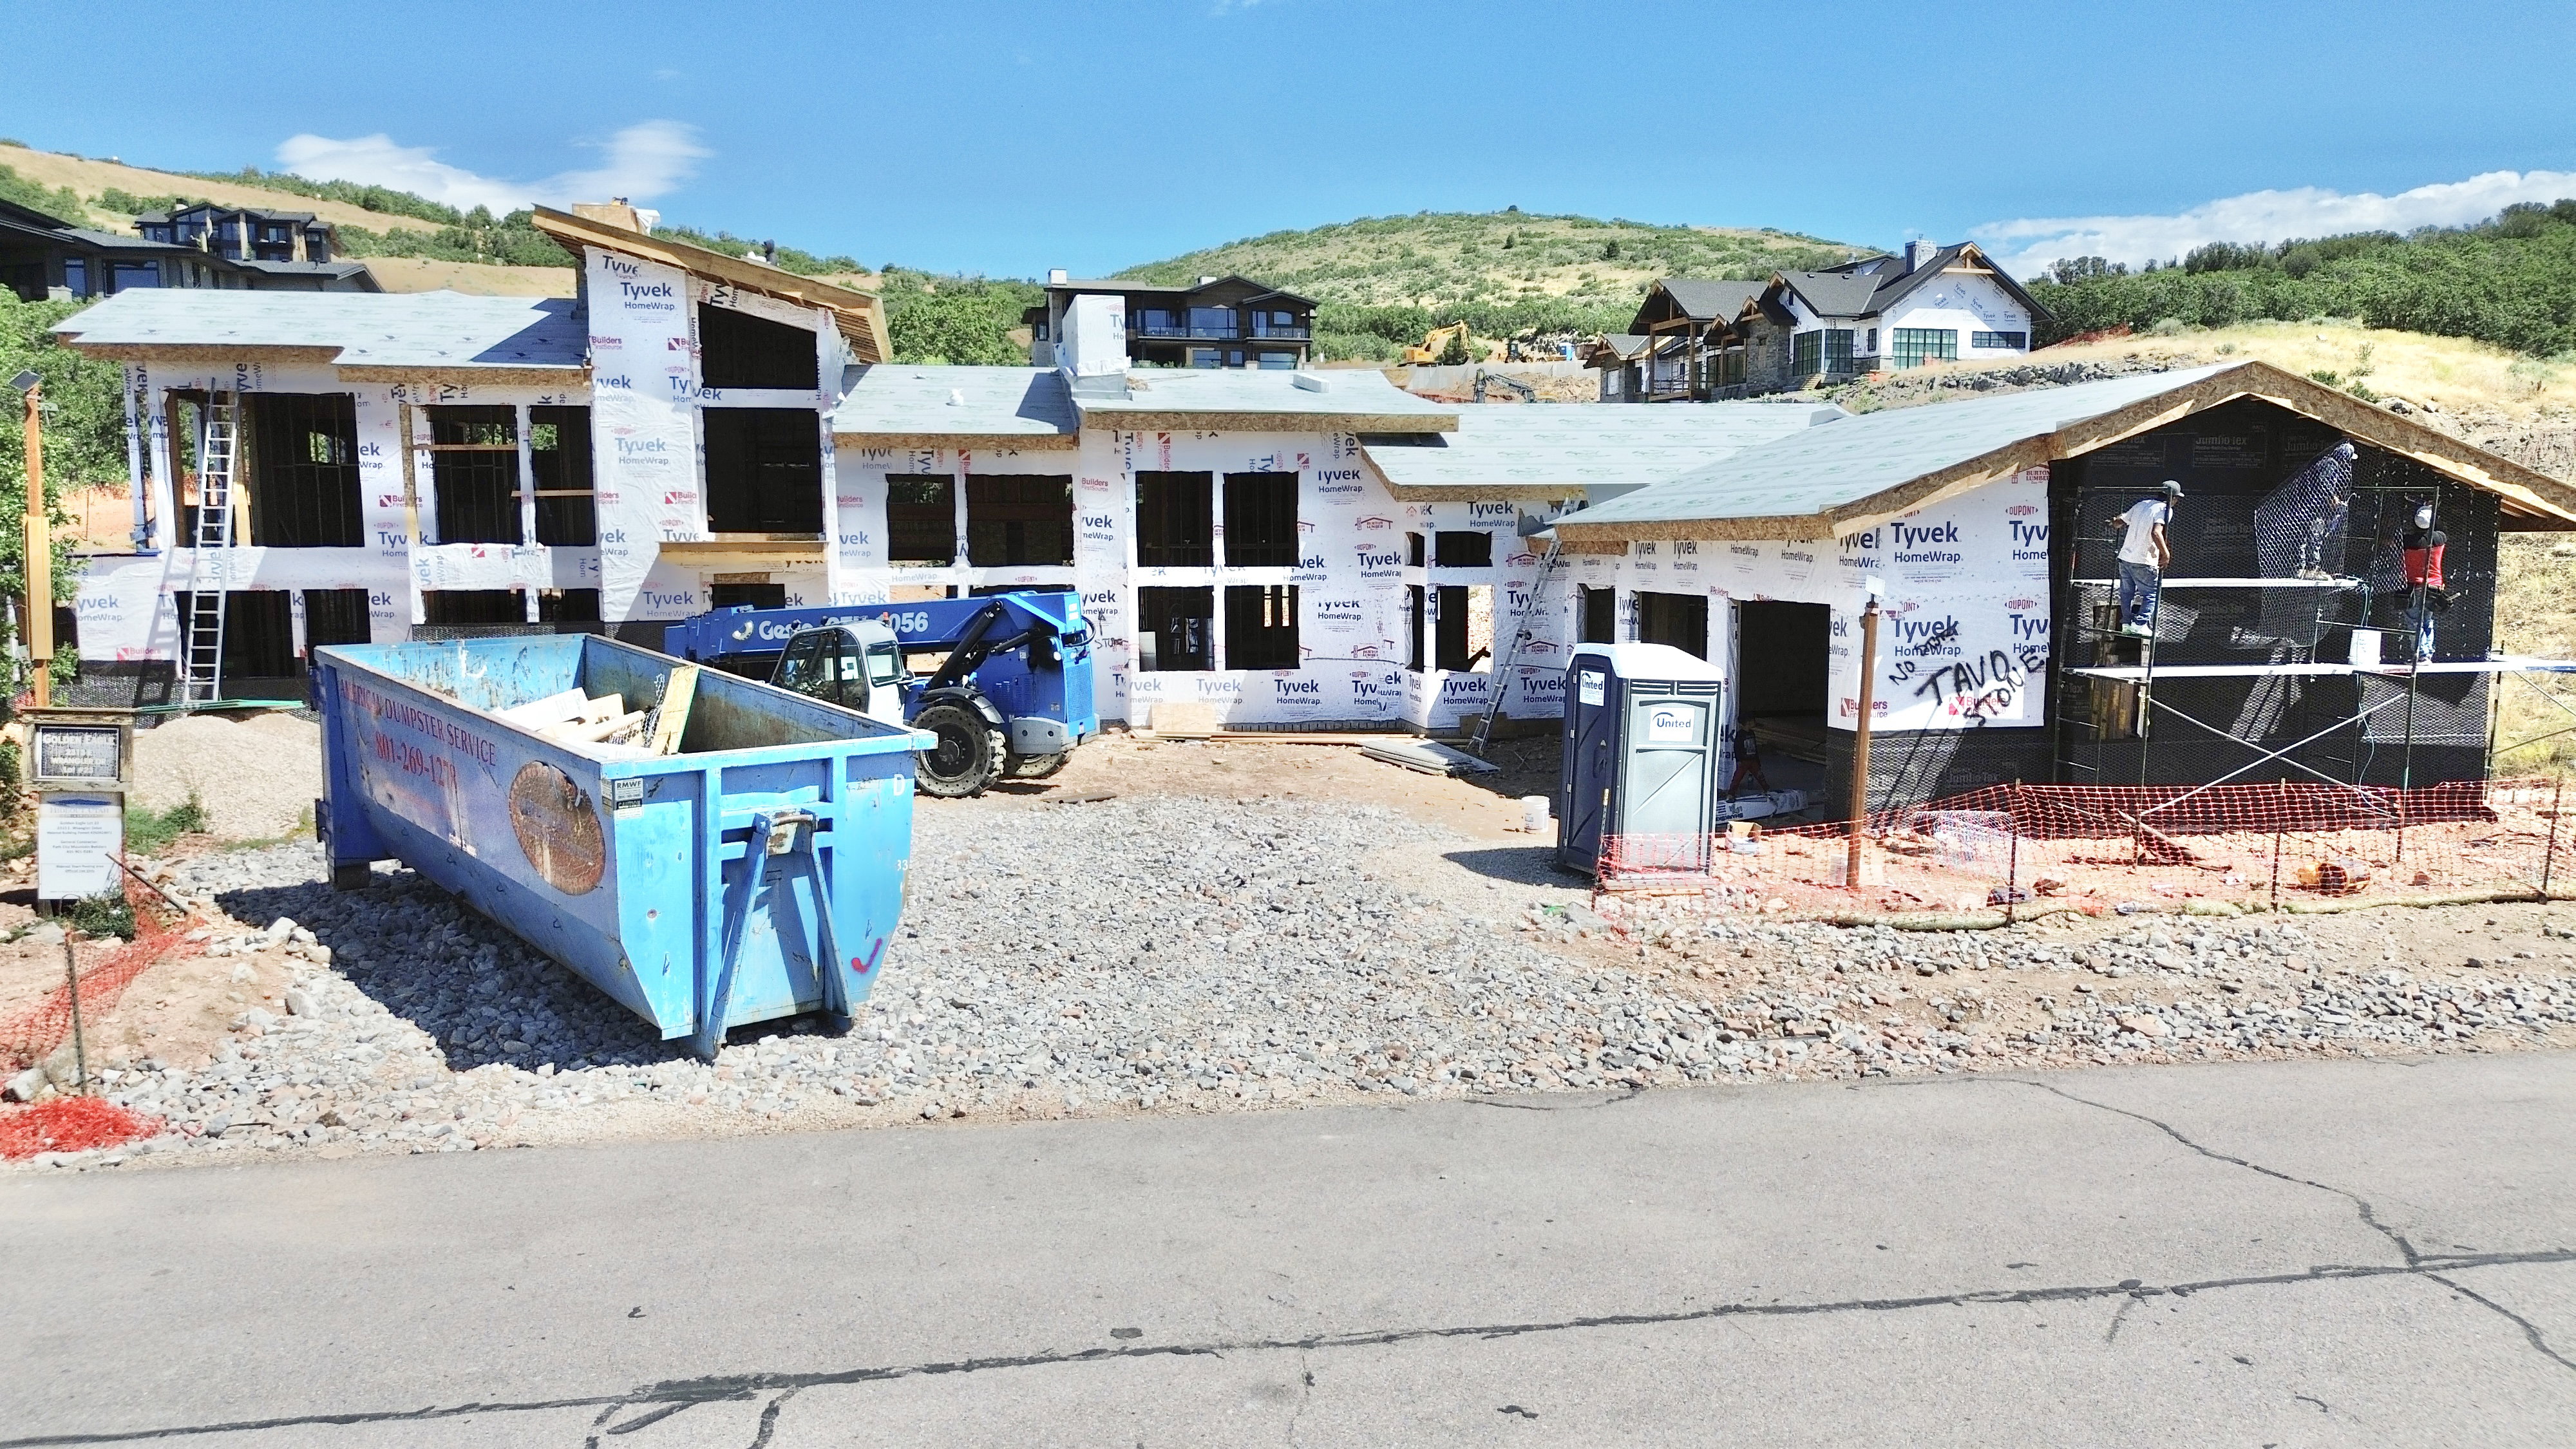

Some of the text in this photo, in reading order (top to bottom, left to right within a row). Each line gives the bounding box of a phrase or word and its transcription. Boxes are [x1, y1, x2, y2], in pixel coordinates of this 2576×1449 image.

[620, 282, 672, 300] Tyvek
[625, 302, 674, 310] HomeWrap
[592, 336, 622, 345] Builders
[615, 437, 666, 455] Tyvek
[619, 457, 669, 465] HomeWrap
[918, 450, 934, 475] Tyv
[1082, 478, 1108, 486] Builders
[1468, 501, 1513, 518] Tyvek
[2009, 506, 2035, 516] DUPONT
[1082, 515, 1112, 529] vek
[1470, 520, 1515, 528] HomeWrap
[378, 531, 428, 548] Tyvk
[600, 529, 625, 543] vek
[840, 531, 869, 545] vek
[1891, 521, 1958, 549] Tyvek
[2009, 520, 2049, 547] Tyv
[601, 548, 629, 556] eWrap
[1634, 540, 1656, 559] Tyvek
[1674, 540, 1698, 559] Tyvek
[1730, 544, 1759, 558] HomeWrap
[1781, 549, 1814, 564] HomeWrap
[2012, 549, 2048, 560] Home
[1299, 555, 1325, 569] vek
[1358, 551, 1401, 569] Tyvek
[1895, 551, 1961, 564] HomeWrap
[415, 557, 432, 587] vek
[1634, 560, 1658, 572] HomeWrap
[1674, 561, 1699, 573] HomeWrap
[892, 572, 937, 583] HomeWrap
[77, 594, 118, 612] yvek
[643, 591, 694, 609] Tyvek
[841, 591, 886, 605] Tyvek
[1082, 590, 1115, 605] yvek
[2009, 599, 2034, 610] DUPONT
[1085, 607, 1118, 616] omeWrap
[1618, 596, 1639, 615] Tyve
[78, 613, 123, 622] omeWrap
[1830, 616, 1848, 638] vek
[1893, 615, 1958, 643] Tyvek
[2009, 614, 2049, 641] Tyv
[1829, 644, 1849, 657] eWrap
[1895, 645, 1961, 658] HomeWrap
[1196, 678, 1242, 695] Tyvek
[1274, 679, 1319, 696] Tyvek
[1352, 680, 1378, 697] Tyv
[1443, 677, 1487, 694] Tyvek
[1520, 676, 1566, 694] Tyvek
[1582, 678, 1604, 690] United
[1198, 696, 1243, 705] HomeWrap
[1276, 697, 1320, 706] HomeWrap
[1443, 696, 1489, 705] HomeWrap
[1850, 697, 1888, 710] Buers
[1656, 717, 1691, 728] United
[385, 698, 446, 741] DUMPSTER
[446, 723, 497, 767] SERVICE
[616, 781, 641, 789] RMWF
[893, 773, 906, 797] D
